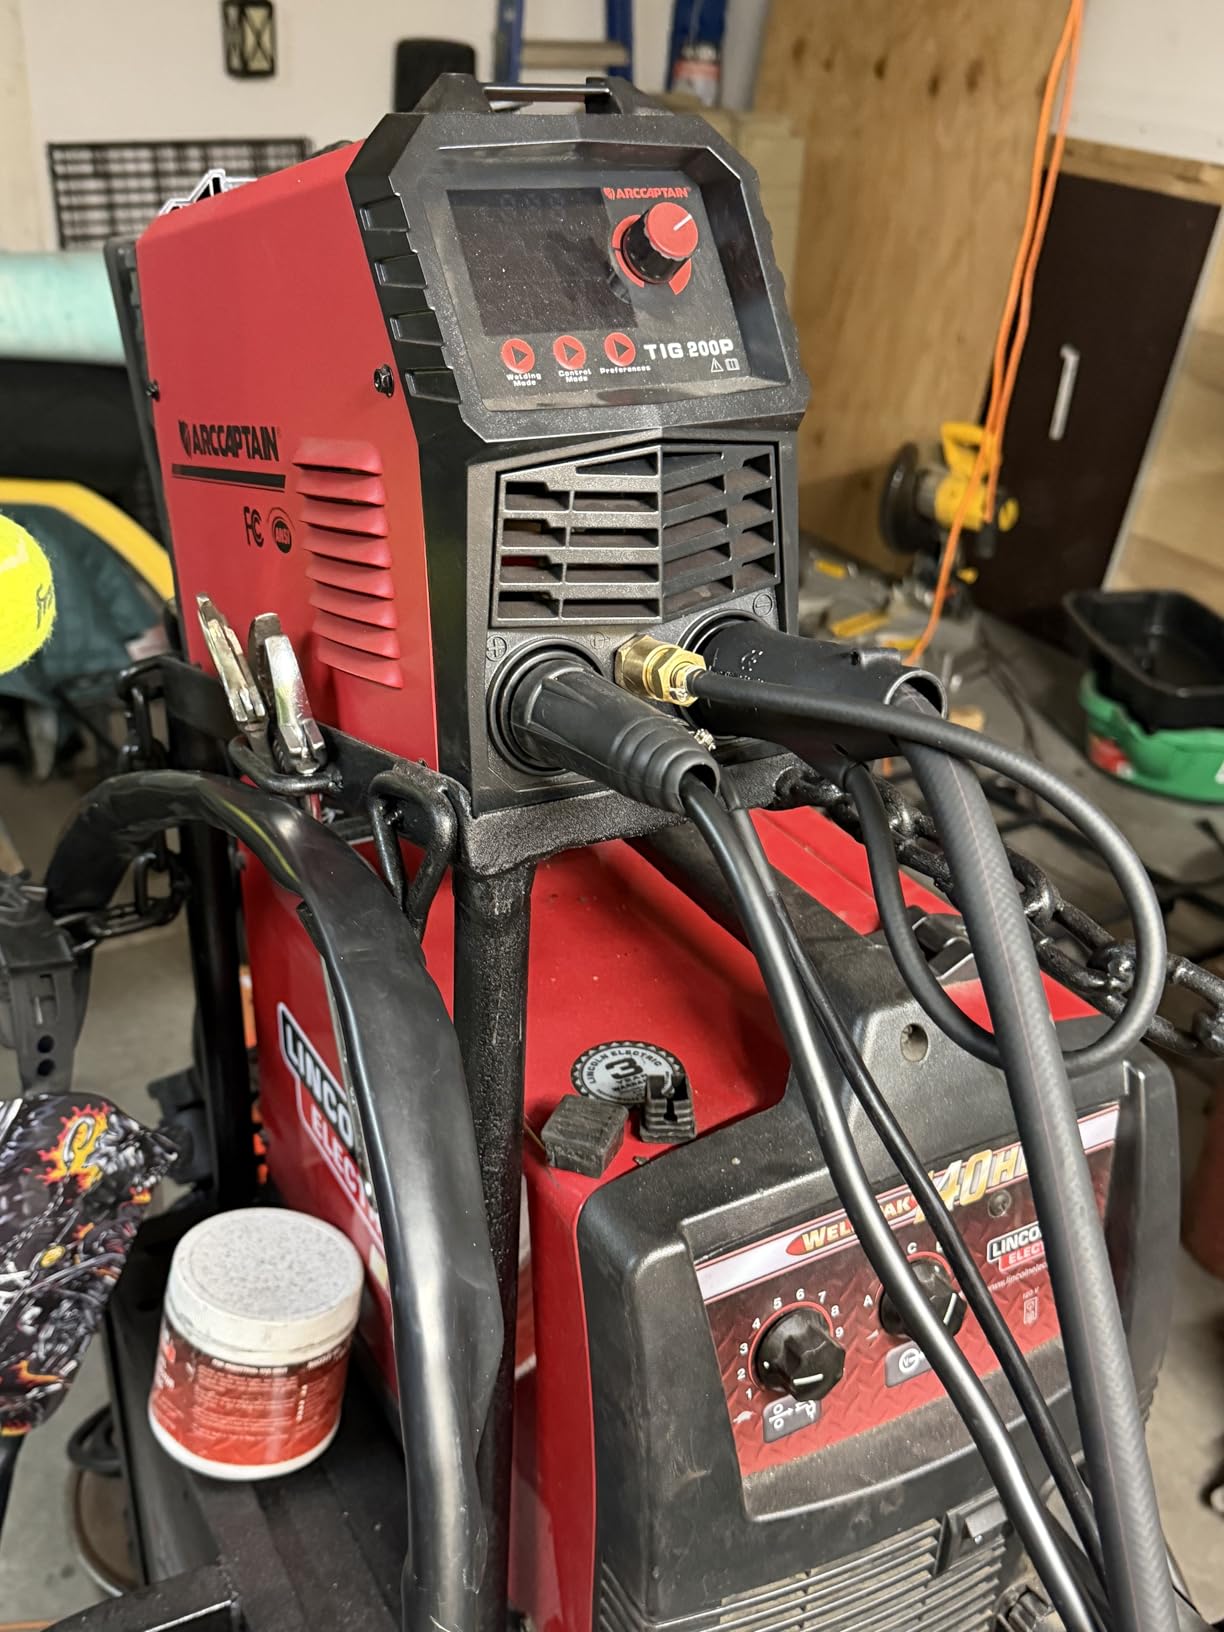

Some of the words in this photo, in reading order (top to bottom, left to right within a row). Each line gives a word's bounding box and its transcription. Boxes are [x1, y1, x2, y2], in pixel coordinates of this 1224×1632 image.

[616, 187, 689, 199] ARCCAPTAIN
[643, 343, 684, 360] TIG
[687, 338, 734, 357] 200P
[558, 367, 592, 377] Control
[600, 364, 652, 375] Preferences
[506, 372, 542, 382] Welding
[565, 375, 589, 383] Mode
[192, 423, 280, 462] ARCCAPTAIN
[586, 1053, 609, 1085] LINCOLN
[610, 1049, 663, 1067] ELECTRIC
[604, 1057, 644, 1080] 3
[284, 1023, 355, 1149] LINCO
[802, 1220, 854, 1251] WEL
[879, 1196, 912, 1217] AK
[907, 1241, 918, 1254] C
[992, 1224, 1042, 1258] LINCO
[1008, 1243, 1043, 1265] ELEC
[795, 1288, 805, 1300] 6
[818, 1290, 827, 1304] 7
[863, 1294, 873, 1307] A
[773, 1297, 783, 1310] 5
[831, 1304, 840, 1317] 8
[751, 1317, 761, 1330] 4
[835, 1326, 844, 1338] 9
[739, 1342, 749, 1355] 3
[736, 1368, 746, 1381] 2
[745, 1387, 753, 1400] 1
